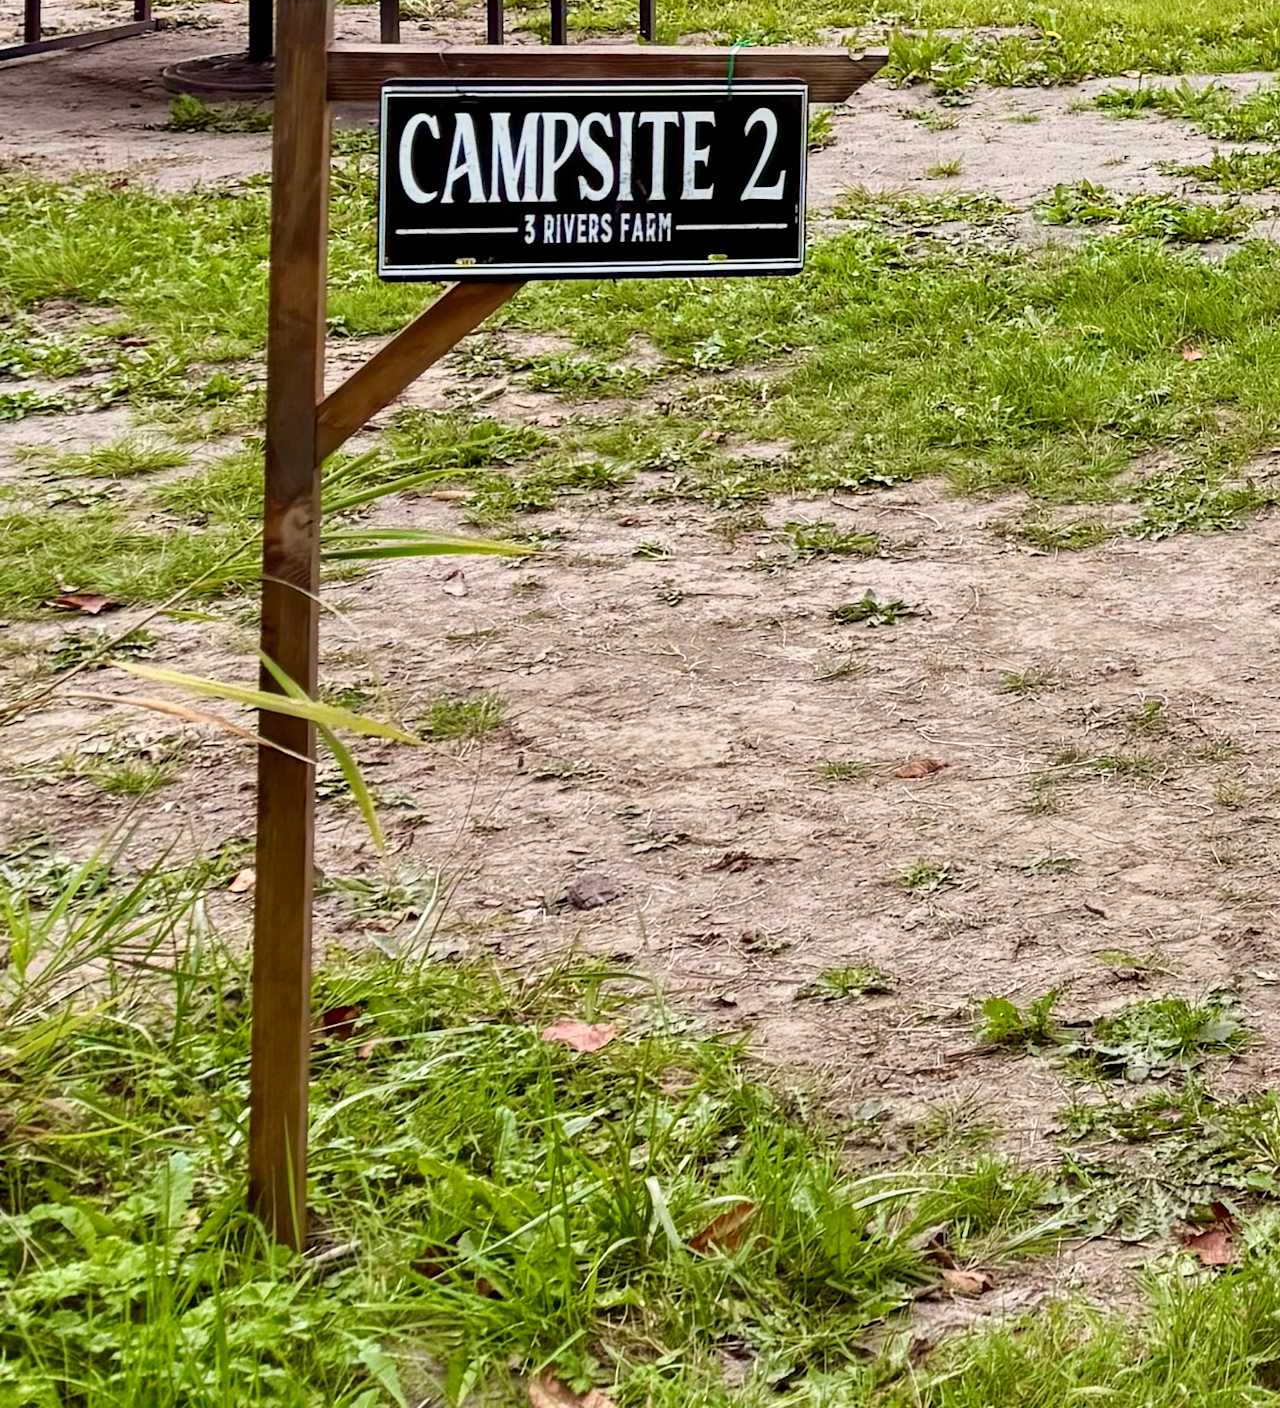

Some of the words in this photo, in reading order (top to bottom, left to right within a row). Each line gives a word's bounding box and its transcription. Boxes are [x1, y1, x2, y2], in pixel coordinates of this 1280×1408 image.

[399, 111, 717, 205] CAMPSITE
[740, 107, 787, 202] 2
[523, 214, 536, 244] 3
[543, 213, 613, 244] RIVERS
[620, 212, 673, 244] FARM
